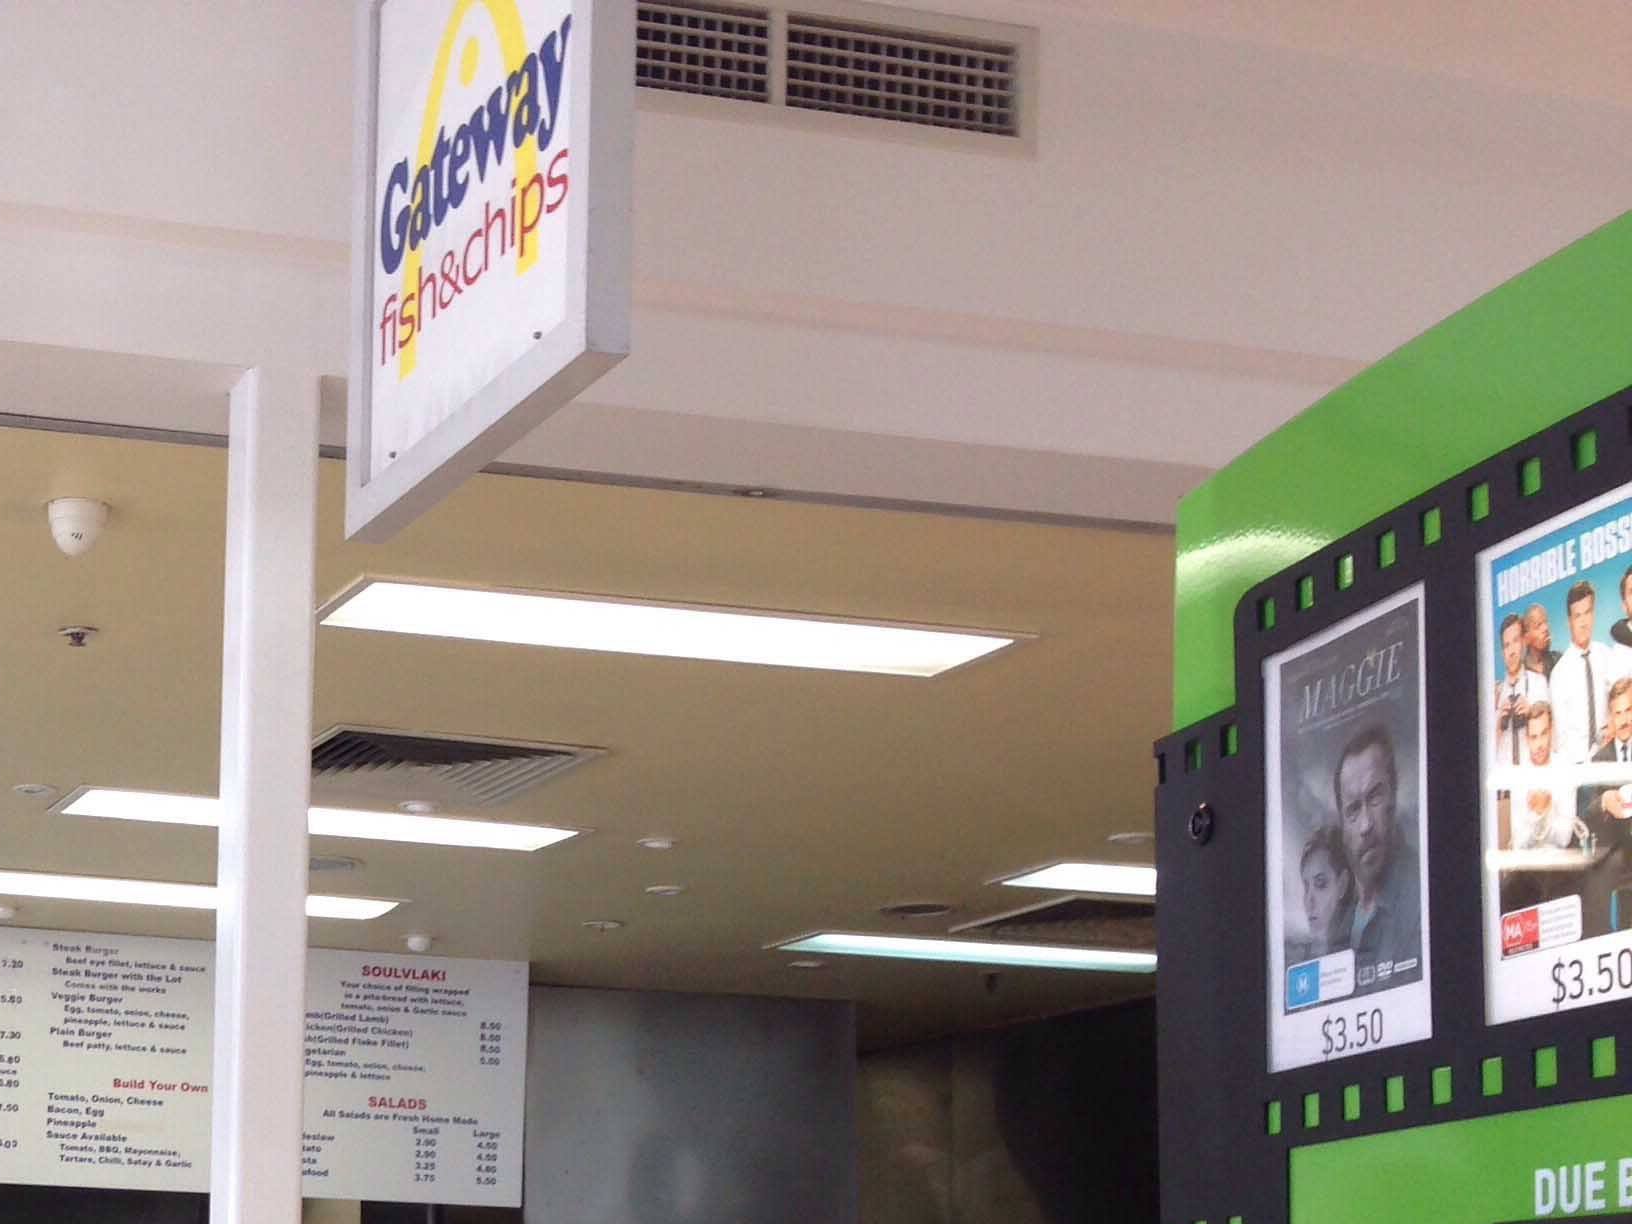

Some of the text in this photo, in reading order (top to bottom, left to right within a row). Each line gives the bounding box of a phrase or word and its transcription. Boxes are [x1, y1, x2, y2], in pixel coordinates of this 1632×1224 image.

[380, 13, 572, 275] Gateway
[380, 148, 569, 366] fish&chips
[1579, 512, 1632, 571] BOSS
[1298, 641, 1403, 724] MAGGIE
[51, 993, 122, 1004] Veggie Burger
[362, 966, 446, 982] SOULVLAKI
[1552, 948, 1632, 1010] $3.50
[49, 1027, 112, 1039] Plain Burger
[1321, 1008, 1383, 1060] $3.50
[113, 1078, 208, 1093] Build Your Own
[368, 1097, 427, 1110] SALADS
[46, 1119, 96, 1129] Pineapple
[1534, 1160, 1606, 1217] DUE
